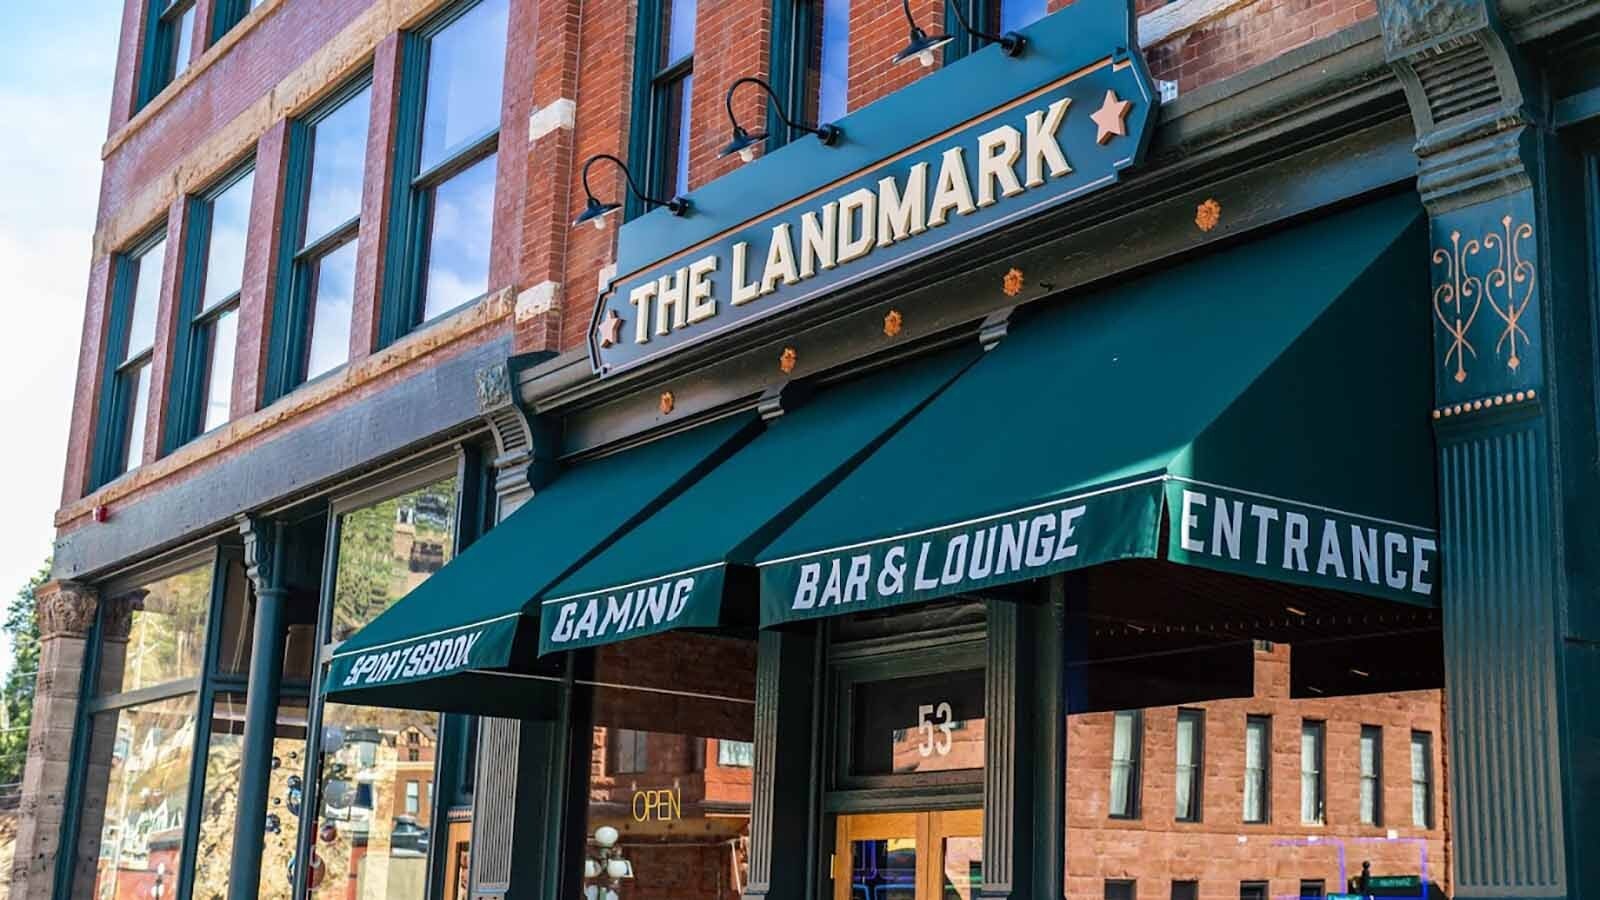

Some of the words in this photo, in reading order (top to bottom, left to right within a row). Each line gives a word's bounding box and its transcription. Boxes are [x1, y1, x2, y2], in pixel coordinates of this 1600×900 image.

[629, 254, 718, 345] THE
[730, 96, 1073, 307] LANDMARK
[914, 505, 1086, 591] LOUNGE
[1181, 489, 1437, 595] ENTRANCE
[551, 577, 695, 643] GAMING
[343, 631, 483, 686] SPORTSBOOK
[917, 702, 953, 757] 53
[632, 787, 682, 822] OPEN
